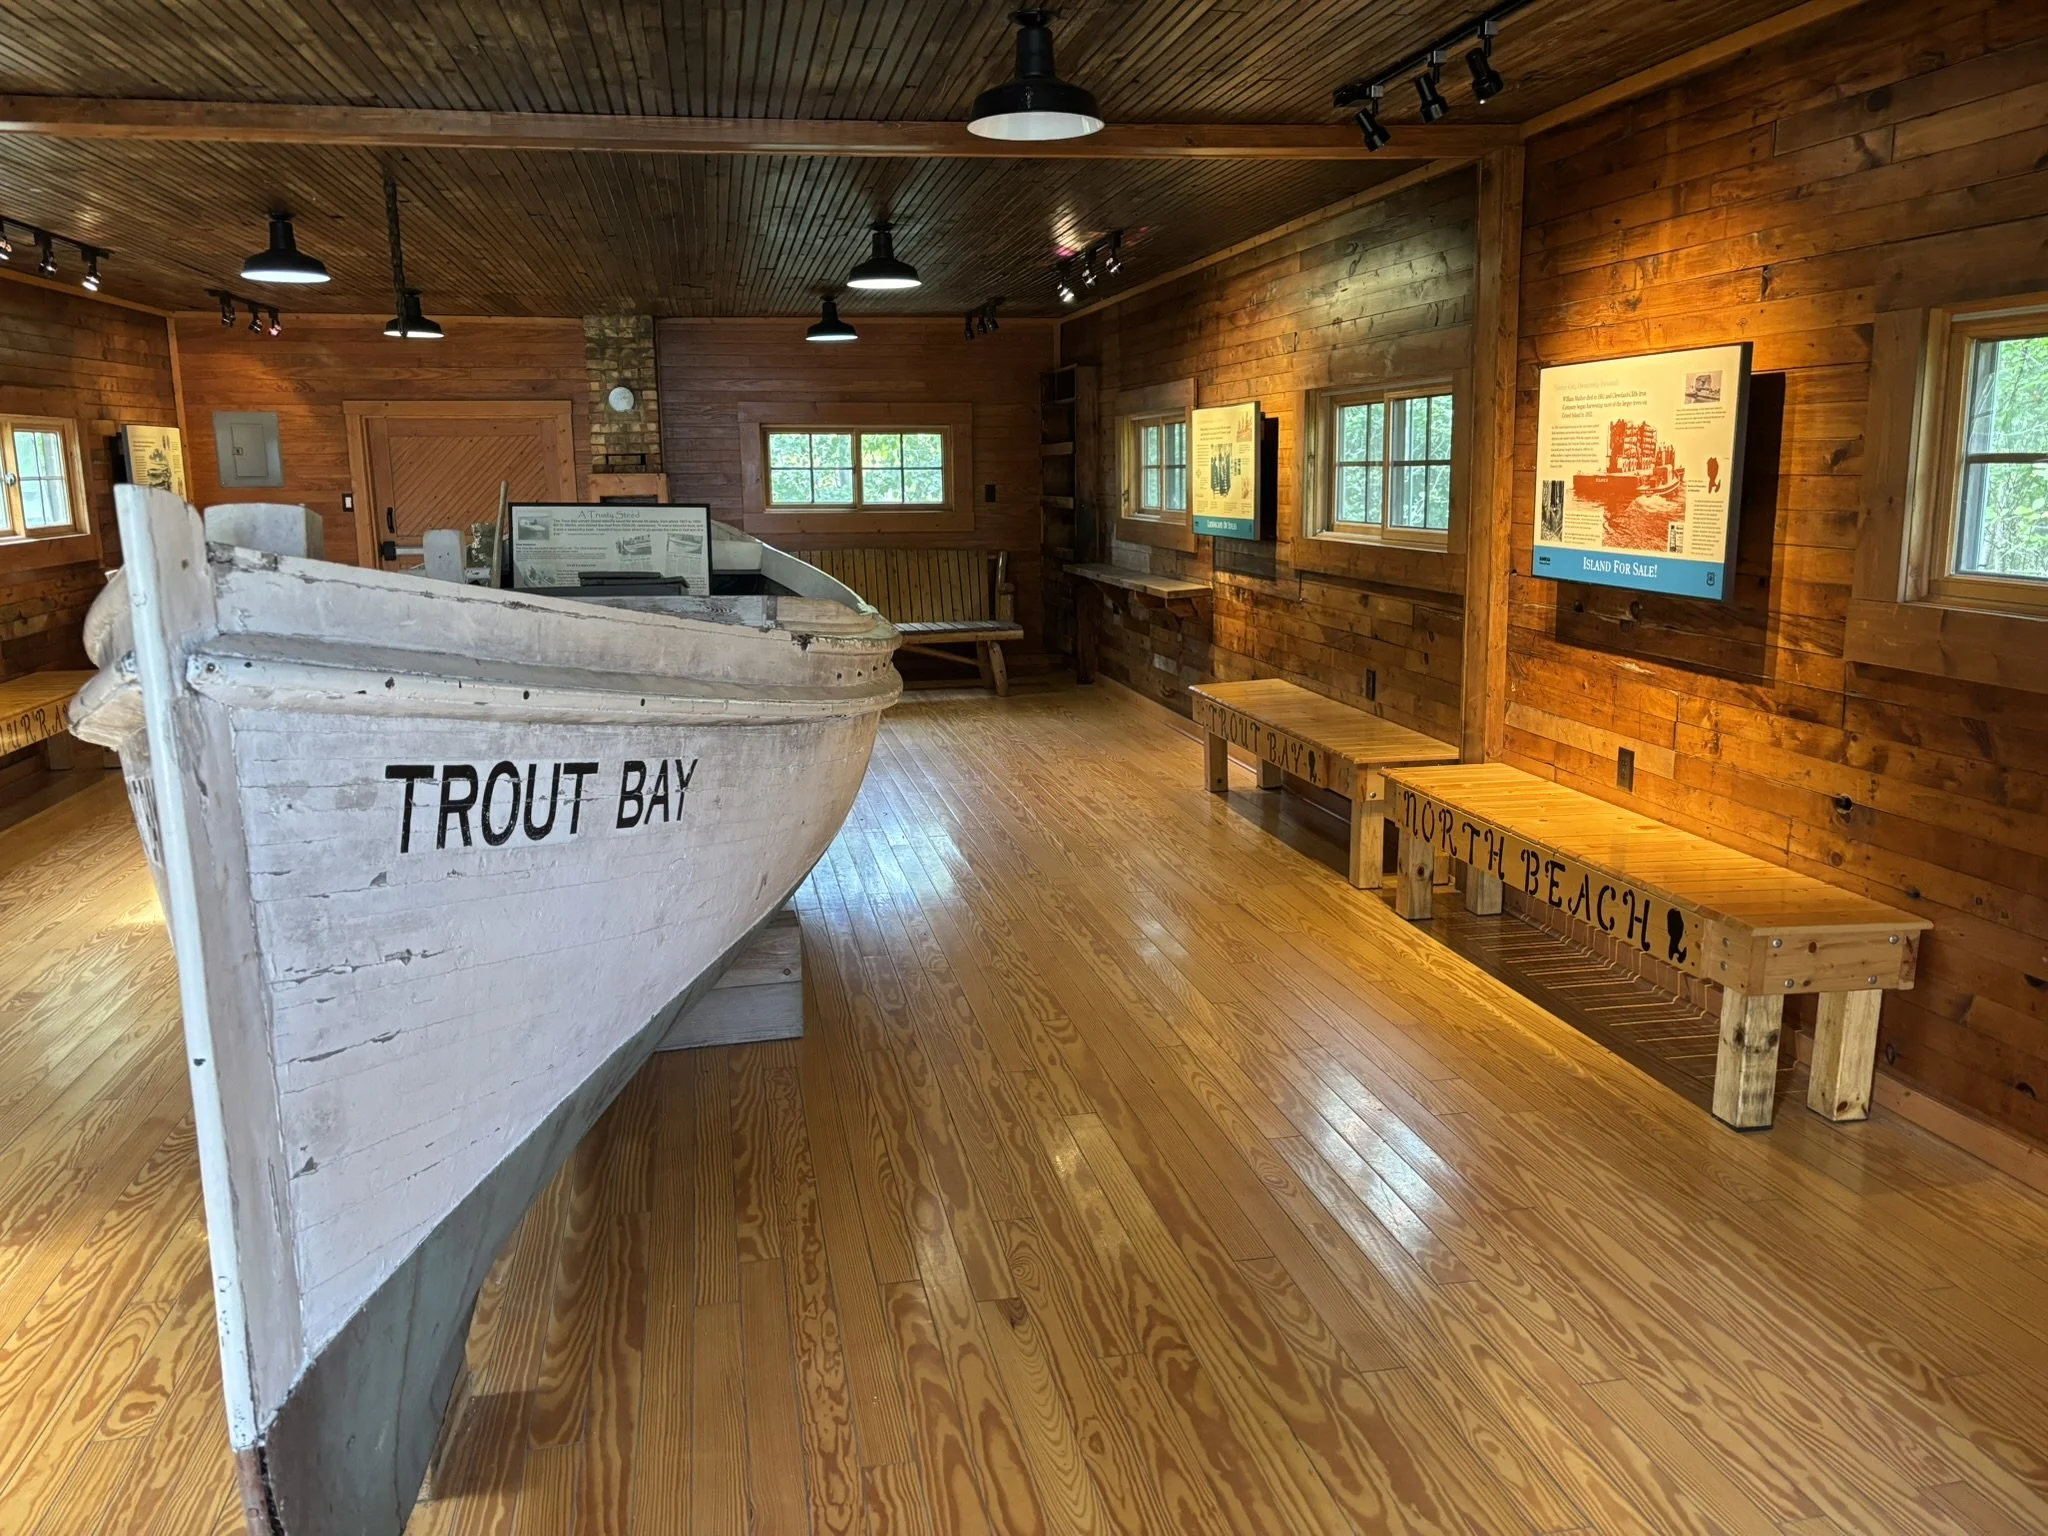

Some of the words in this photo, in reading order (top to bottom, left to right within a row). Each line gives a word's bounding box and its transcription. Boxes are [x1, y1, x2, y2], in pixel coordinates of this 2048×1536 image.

[577, 509, 586, 519] A
[587, 510, 614, 521] Trusty
[615, 510, 640, 520] Steed
[1583, 556, 1611, 573] ISLAND
[1613, 559, 1631, 576] FOR
[1632, 561, 1658, 578] SALE!
[1208, 703, 1261, 753] TROUT
[1266, 731, 1304, 774] BAY
[385, 760, 599, 854] TROUT
[616, 758, 698, 829] BAY
[1403, 789, 1505, 881] NORTH
[1520, 849, 1651, 952] BEACH
